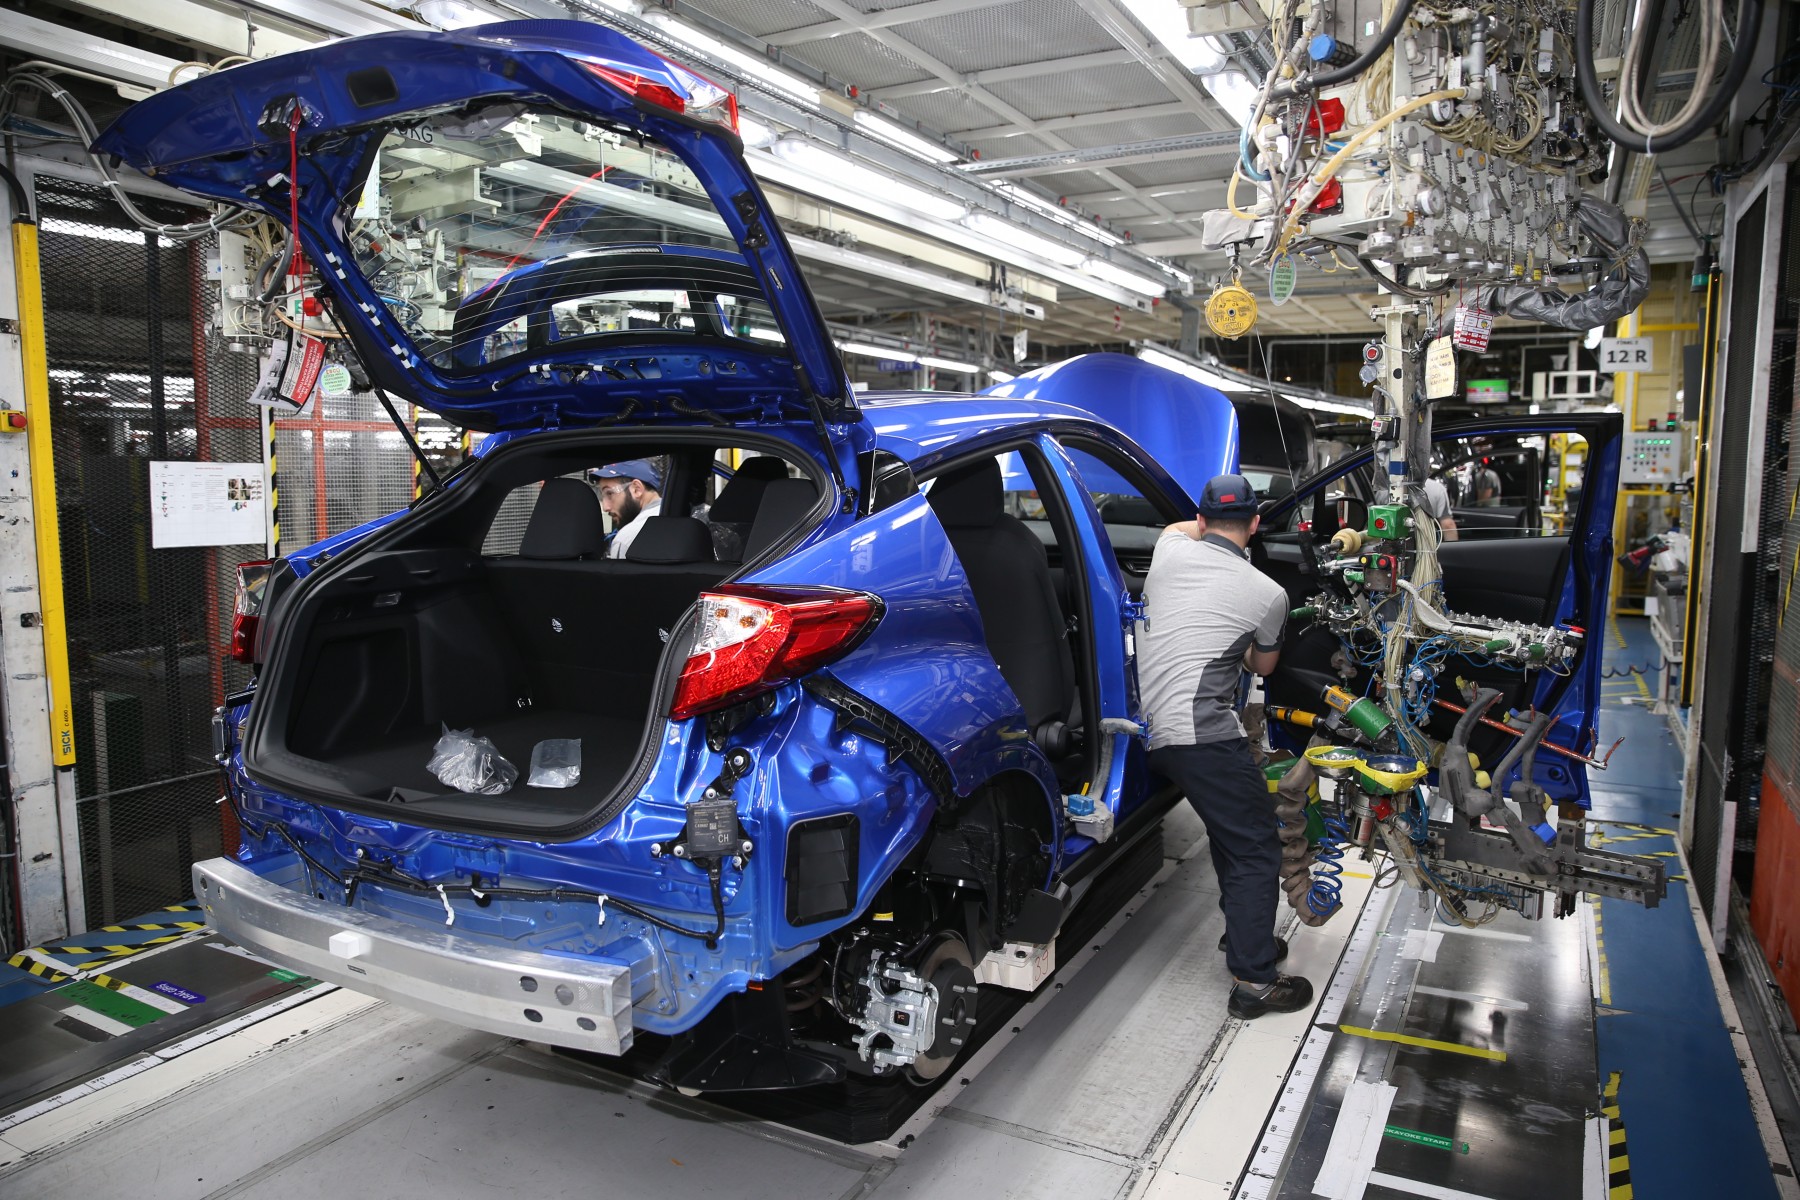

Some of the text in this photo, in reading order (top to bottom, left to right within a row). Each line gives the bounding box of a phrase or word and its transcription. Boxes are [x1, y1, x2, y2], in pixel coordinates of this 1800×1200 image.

[1607, 350, 1647, 363] 12 R
[61, 731, 71, 756] SICK
[718, 834, 729, 843] CH
[1035, 949, 1049, 982] 39
[0, 1114, 16, 1123] 350
[1423, 1136, 1451, 1146] START
[1261, 1145, 1269, 1154] 480
[1241, 1191, 1249, 1200] 460
